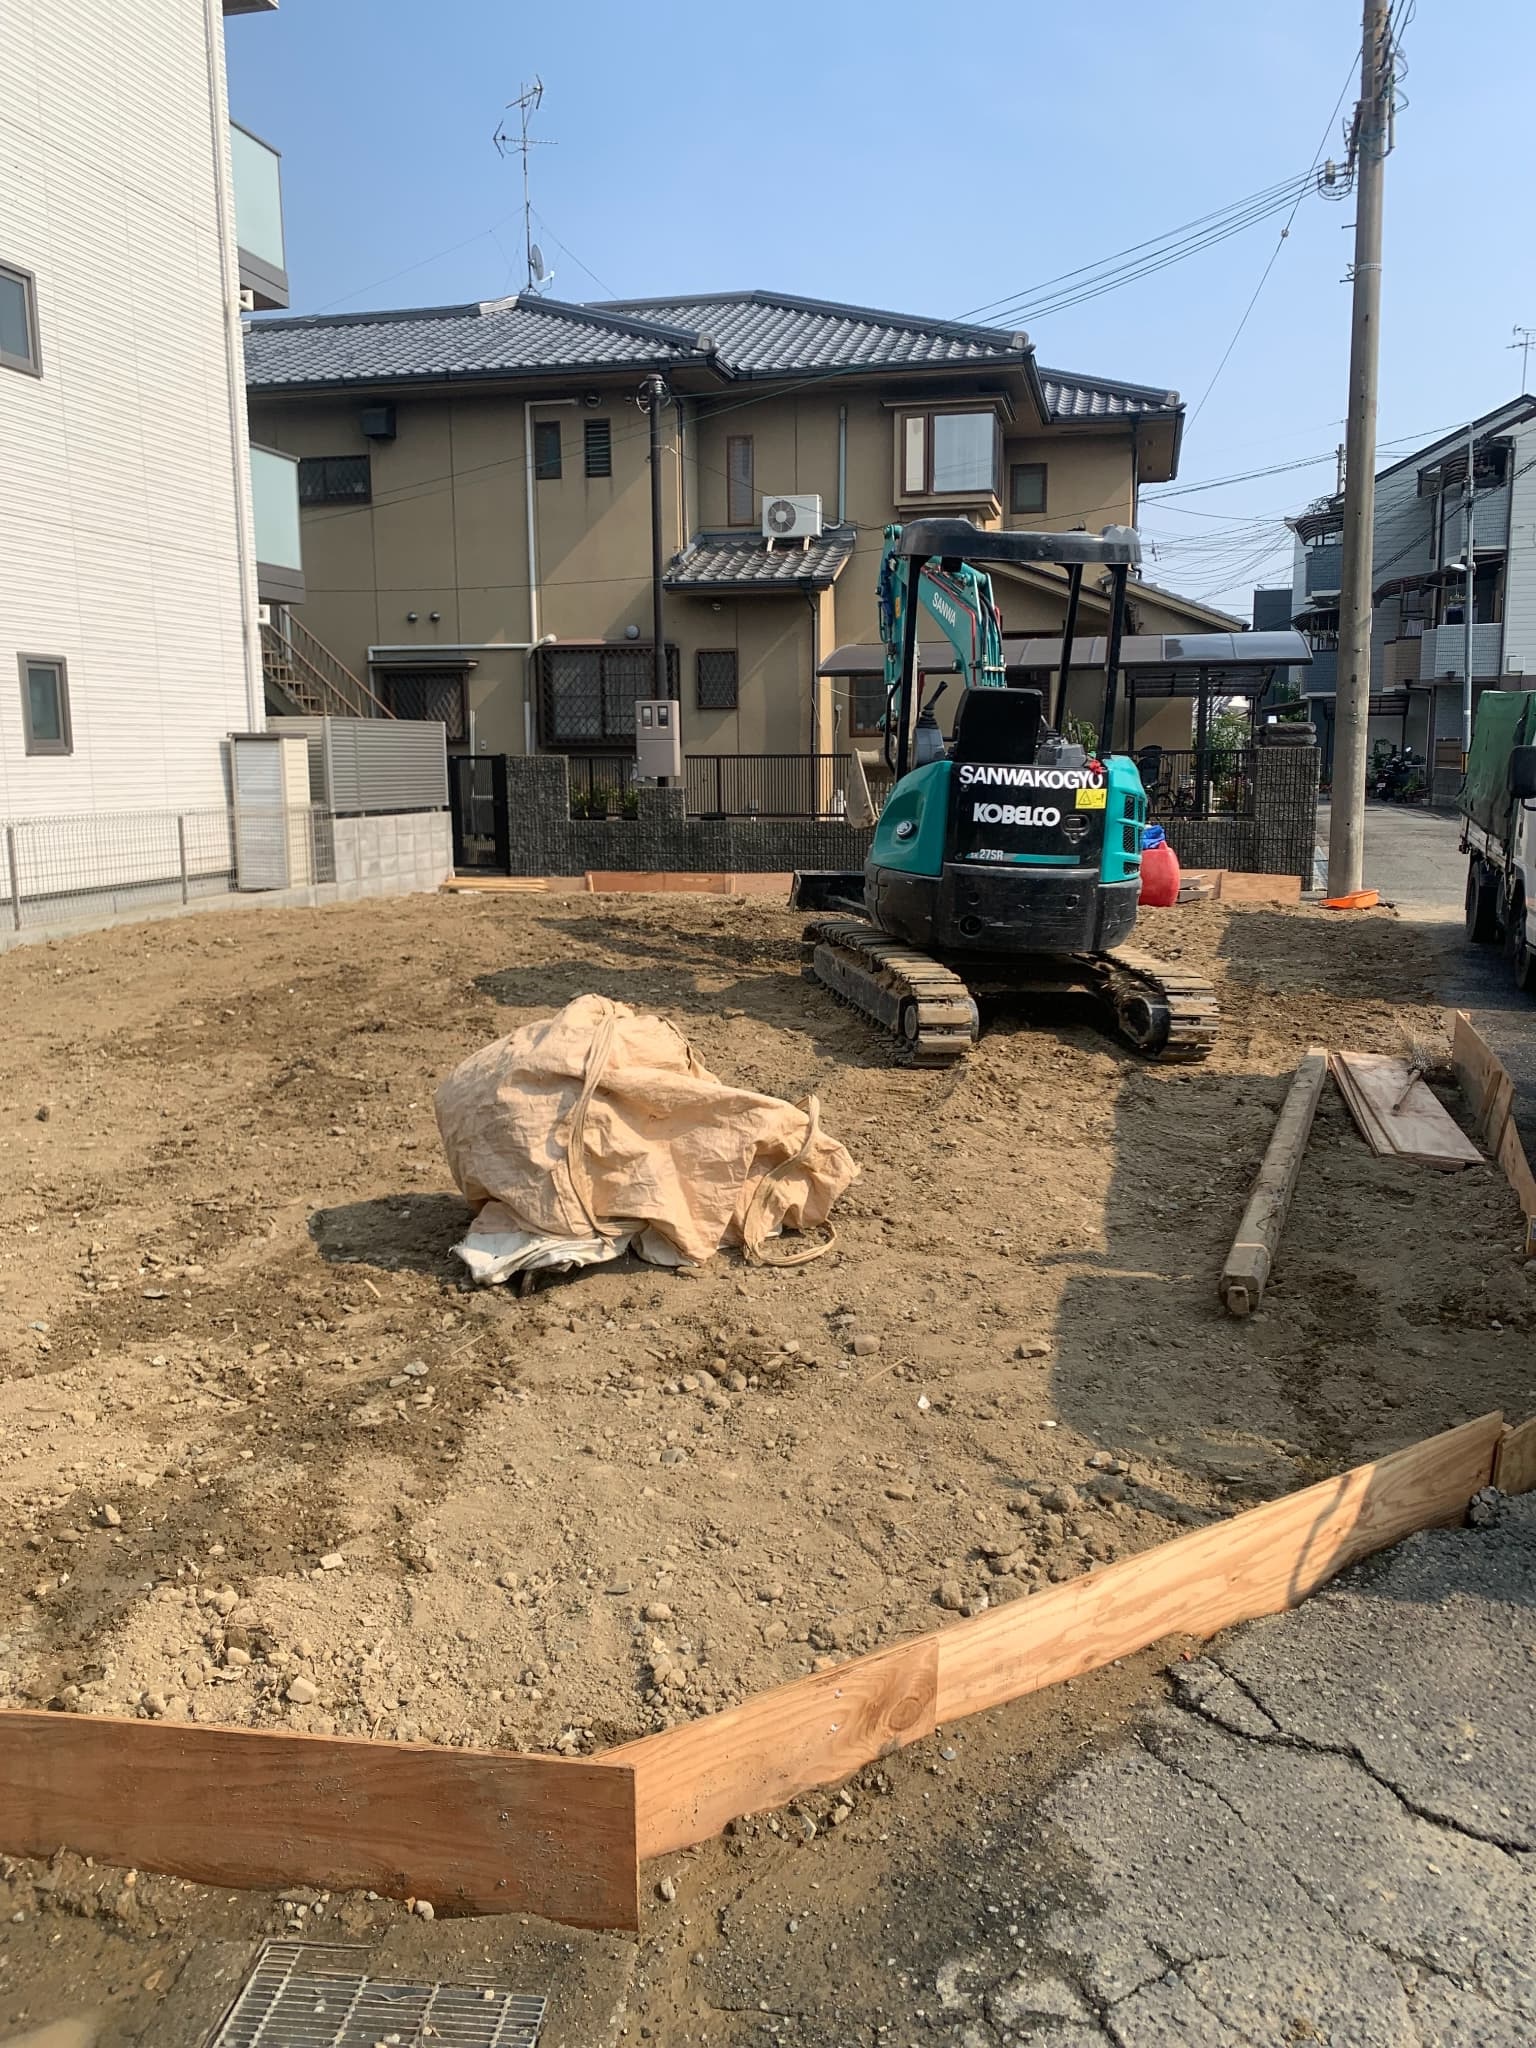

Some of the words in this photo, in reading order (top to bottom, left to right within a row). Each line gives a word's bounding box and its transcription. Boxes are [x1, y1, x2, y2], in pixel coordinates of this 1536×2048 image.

[932, 592, 956, 628] SANWA
[959, 765, 1104, 789] SANWAKOGYO
[972, 802, 1061, 827] KOBELCO
